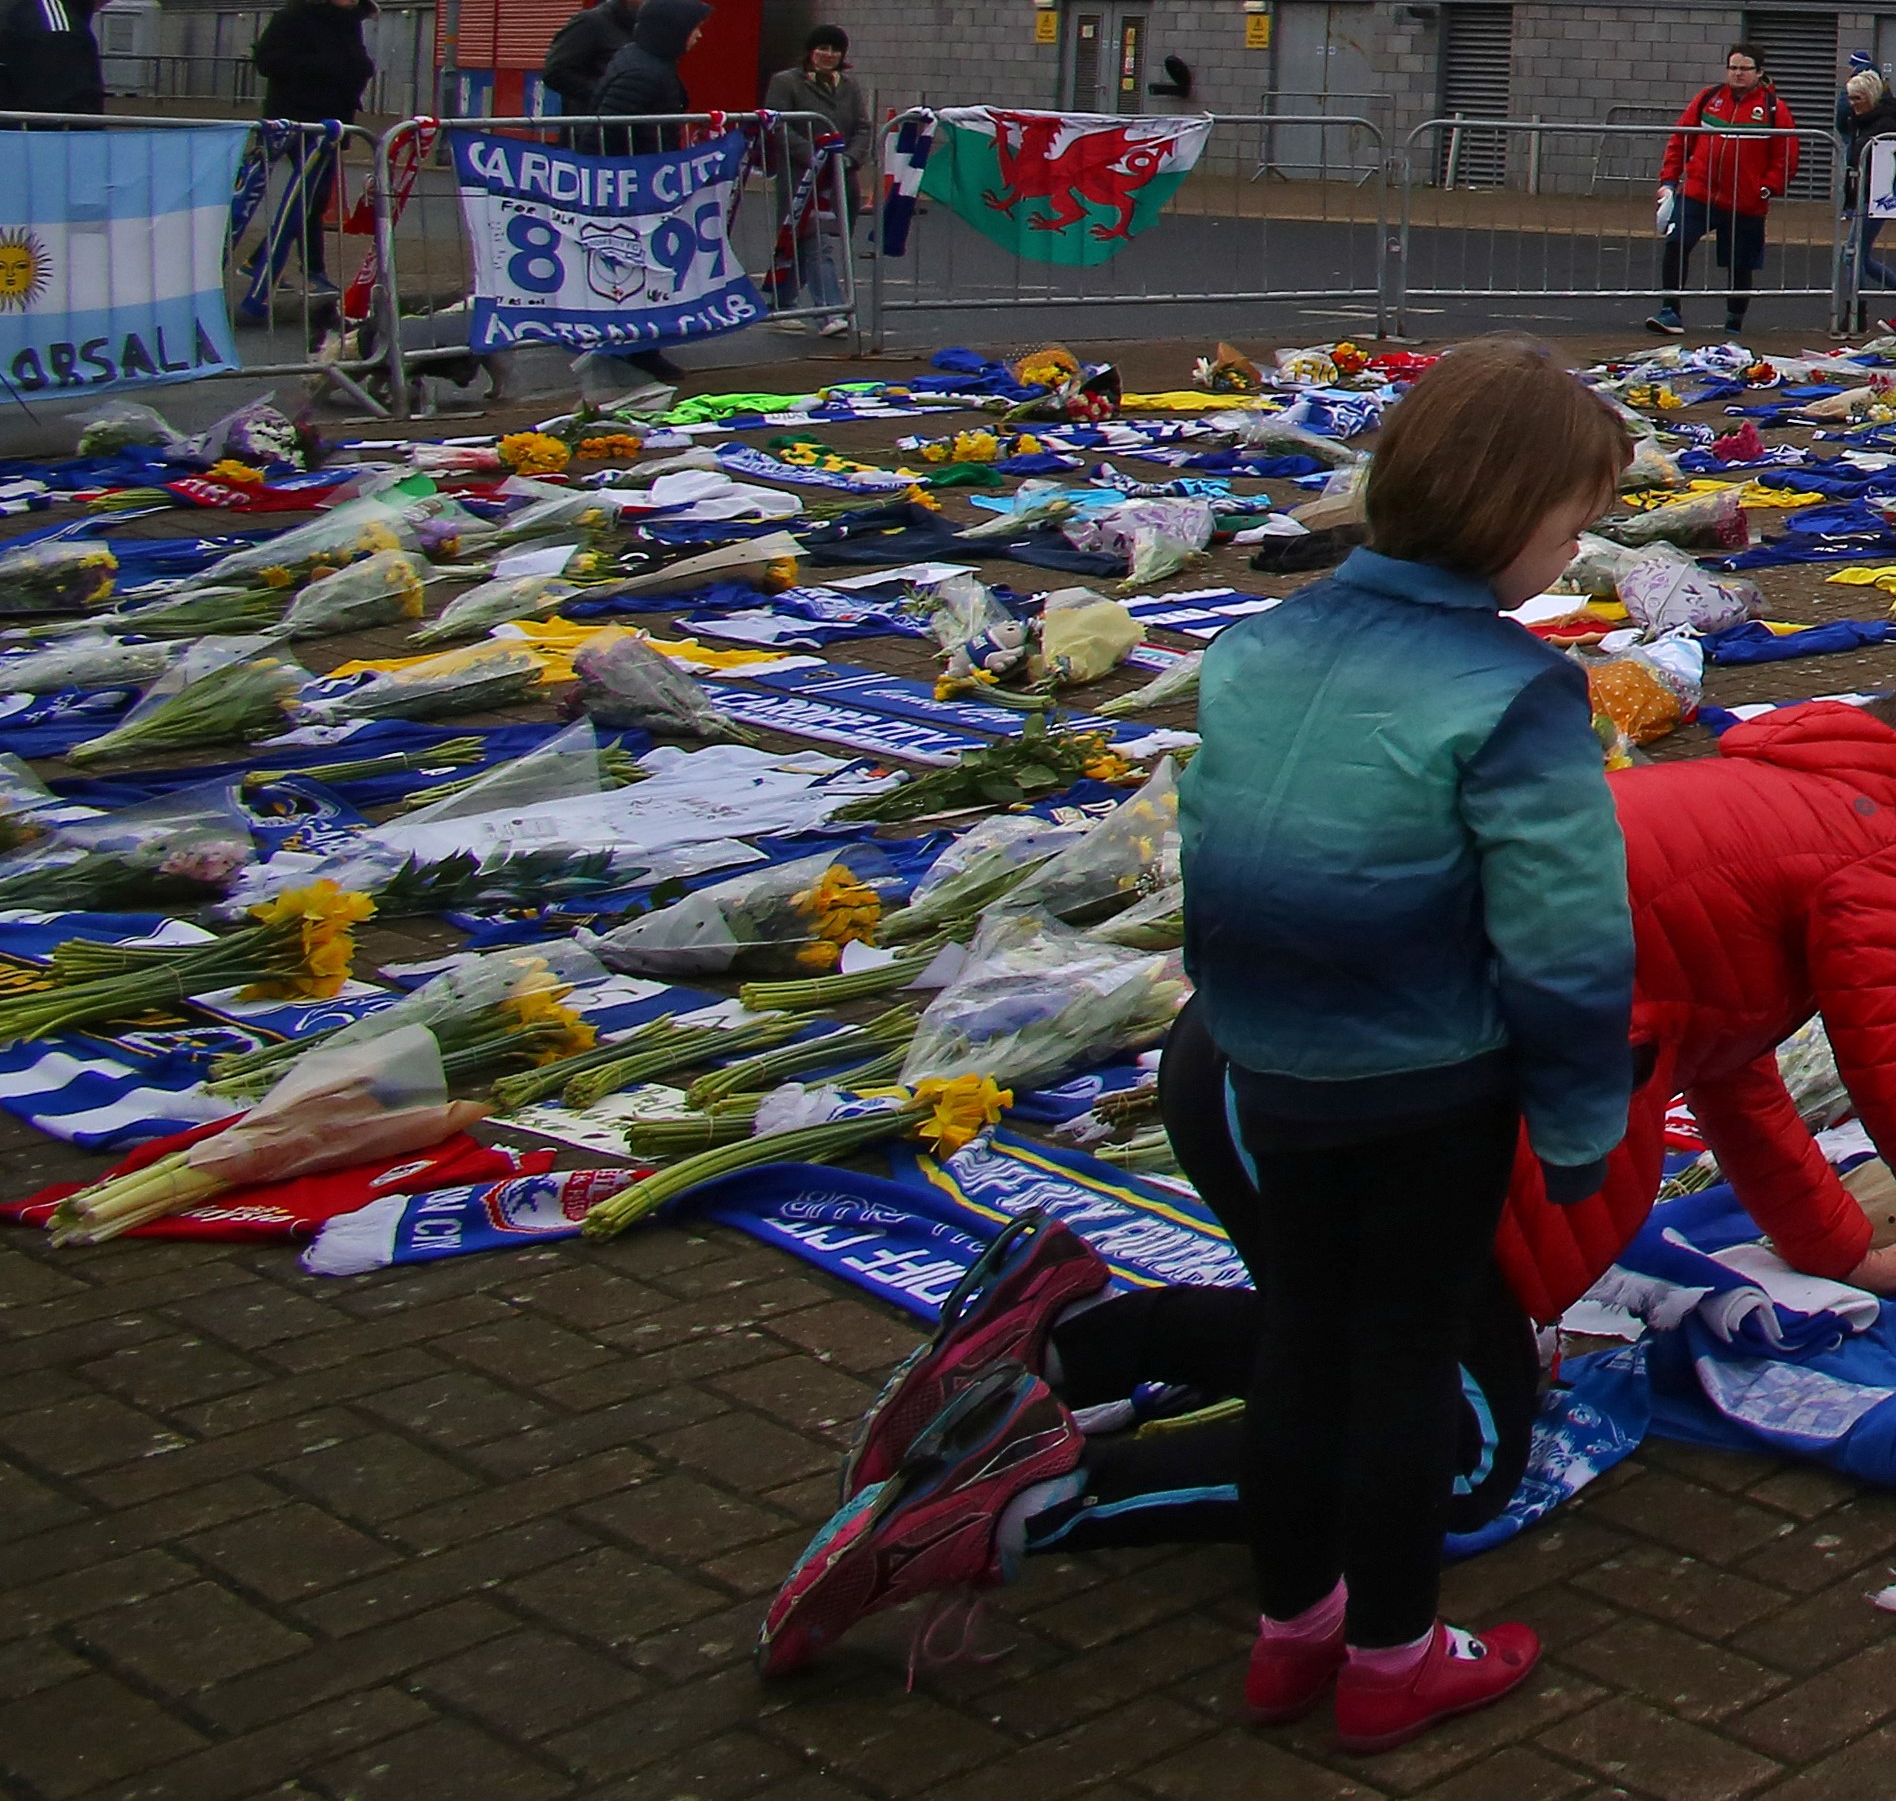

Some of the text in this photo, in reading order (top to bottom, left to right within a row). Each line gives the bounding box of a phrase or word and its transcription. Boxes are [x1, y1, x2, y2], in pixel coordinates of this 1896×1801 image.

[468, 141, 727, 207] CARDIFF CITY
[501, 200, 537, 216] FOR
[711, 692, 964, 752] CARDIFF CITY
